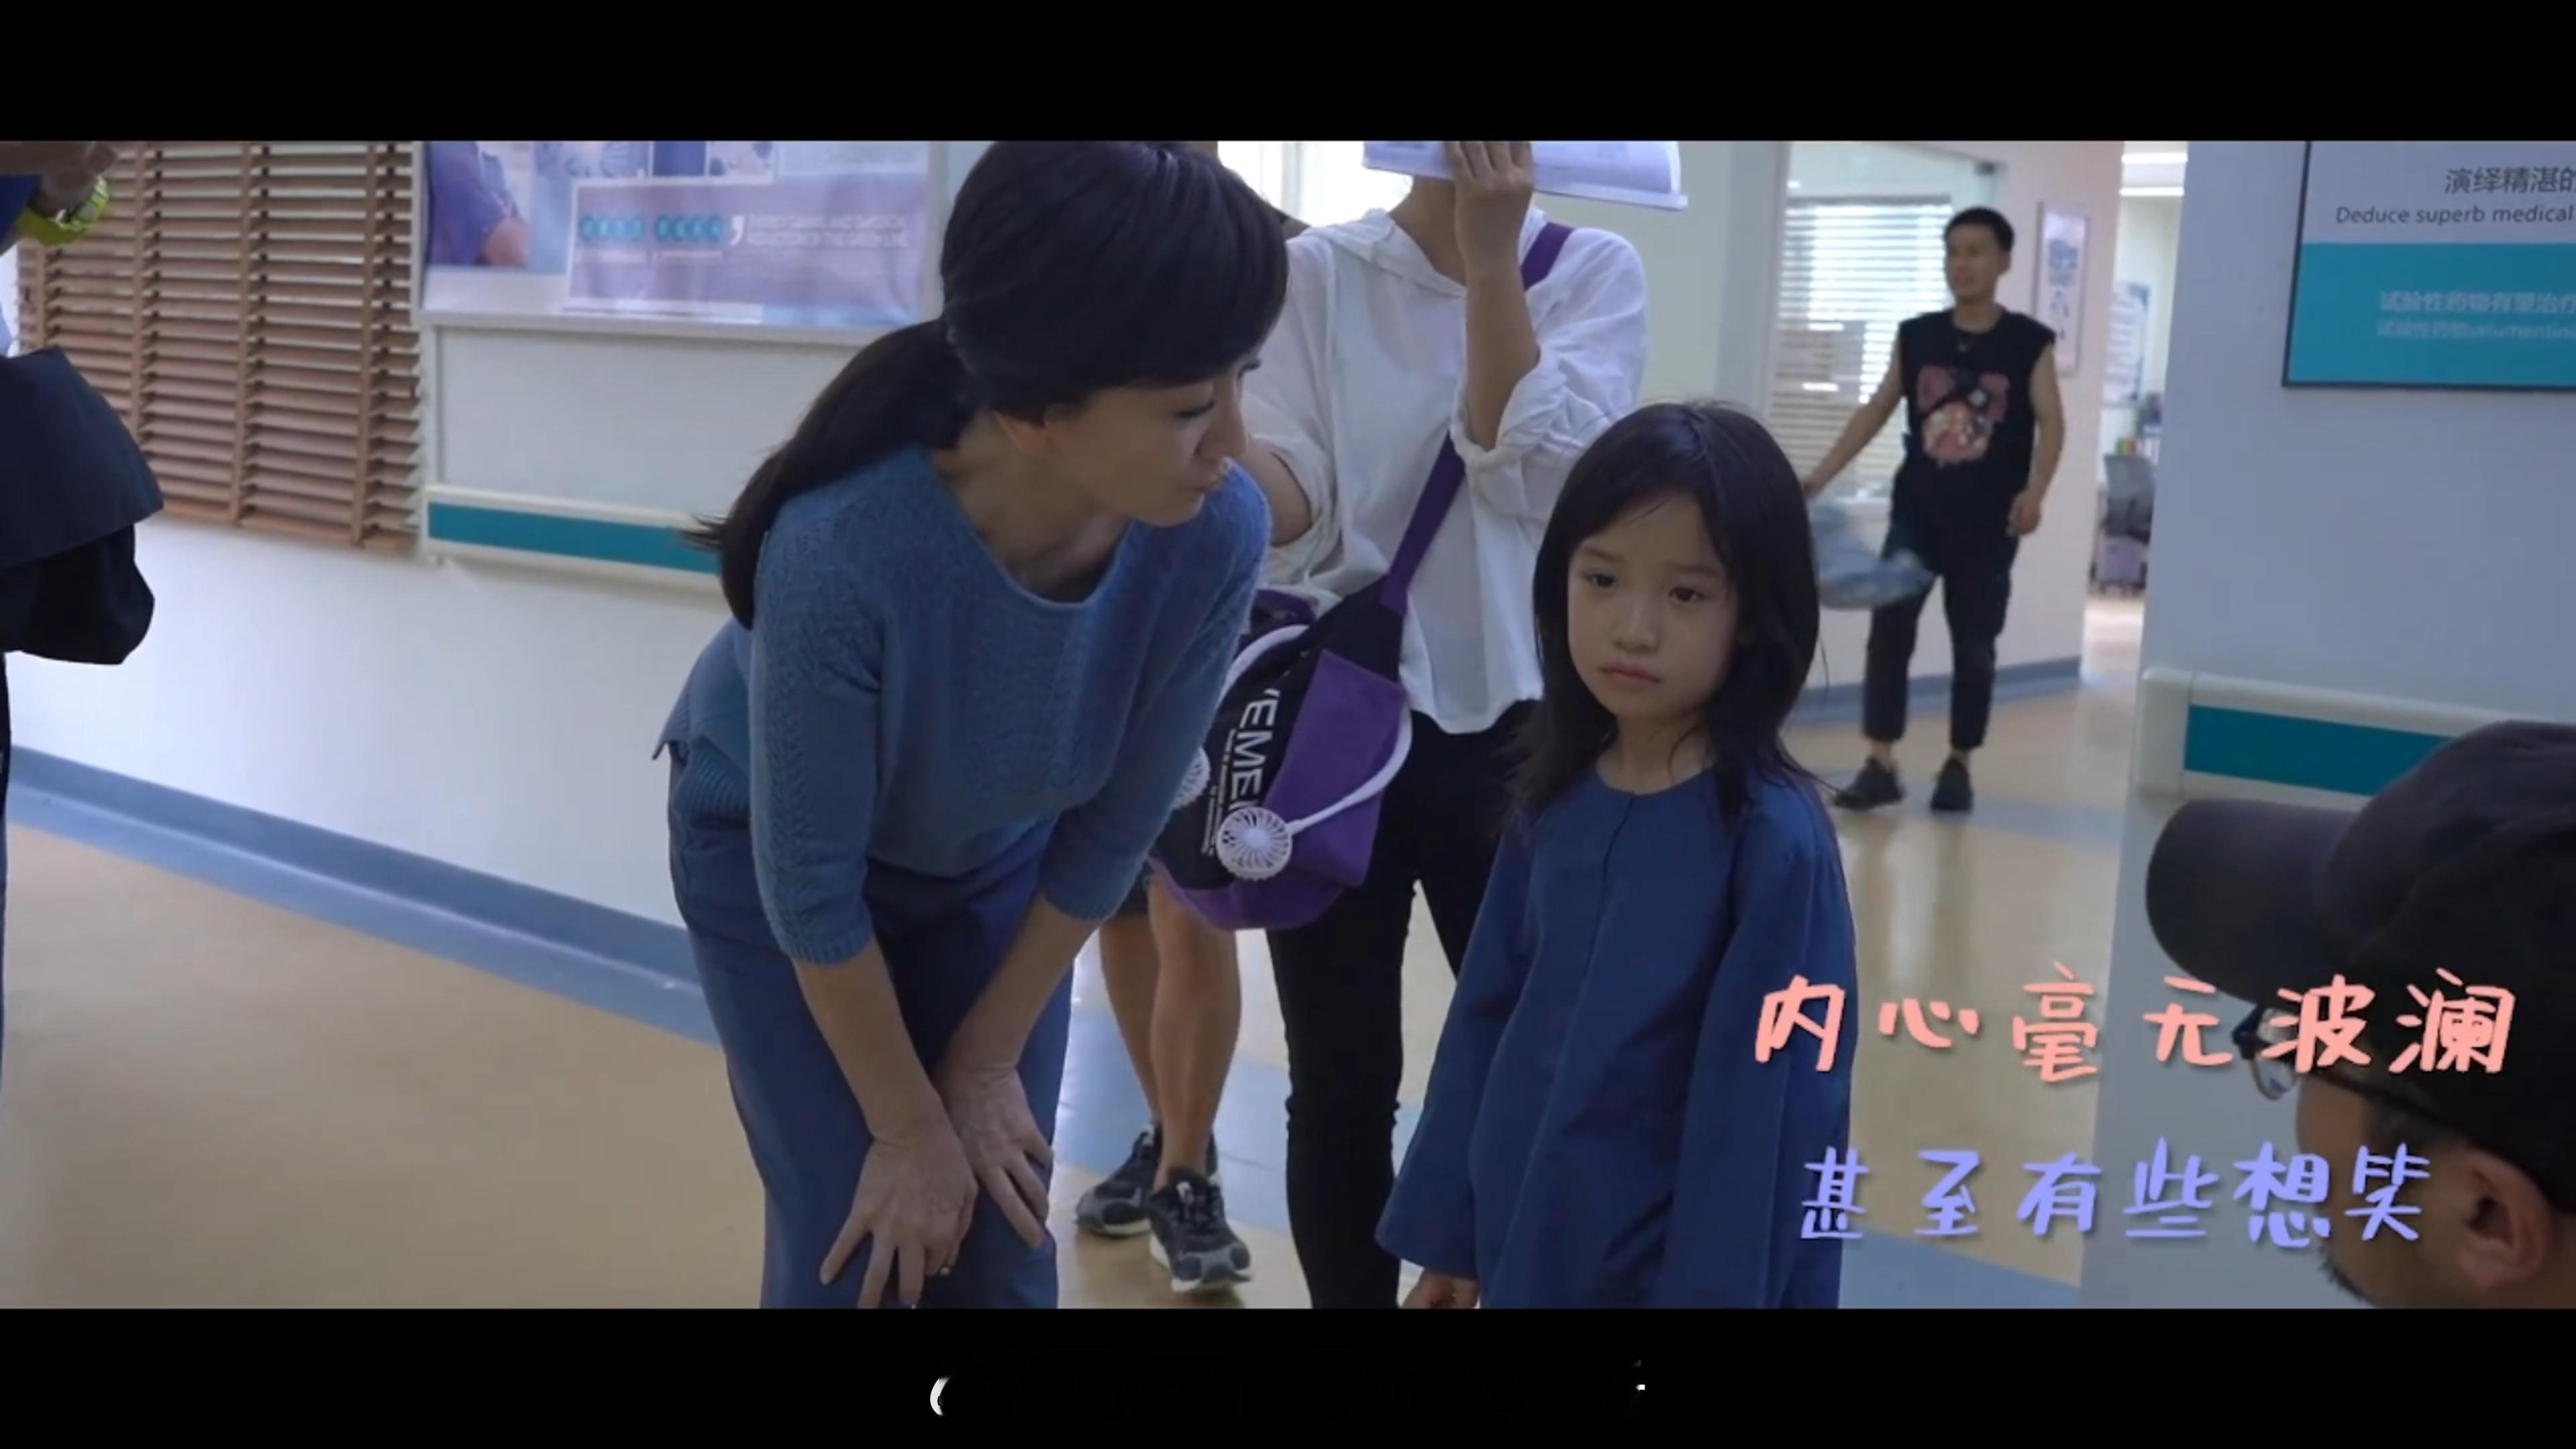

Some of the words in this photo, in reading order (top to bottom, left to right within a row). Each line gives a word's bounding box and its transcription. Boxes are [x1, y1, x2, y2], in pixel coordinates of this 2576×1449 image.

[2336, 205, 2410, 223] Deduce
[2415, 205, 2485, 226] superb
[2492, 204, 2573, 223] medical
